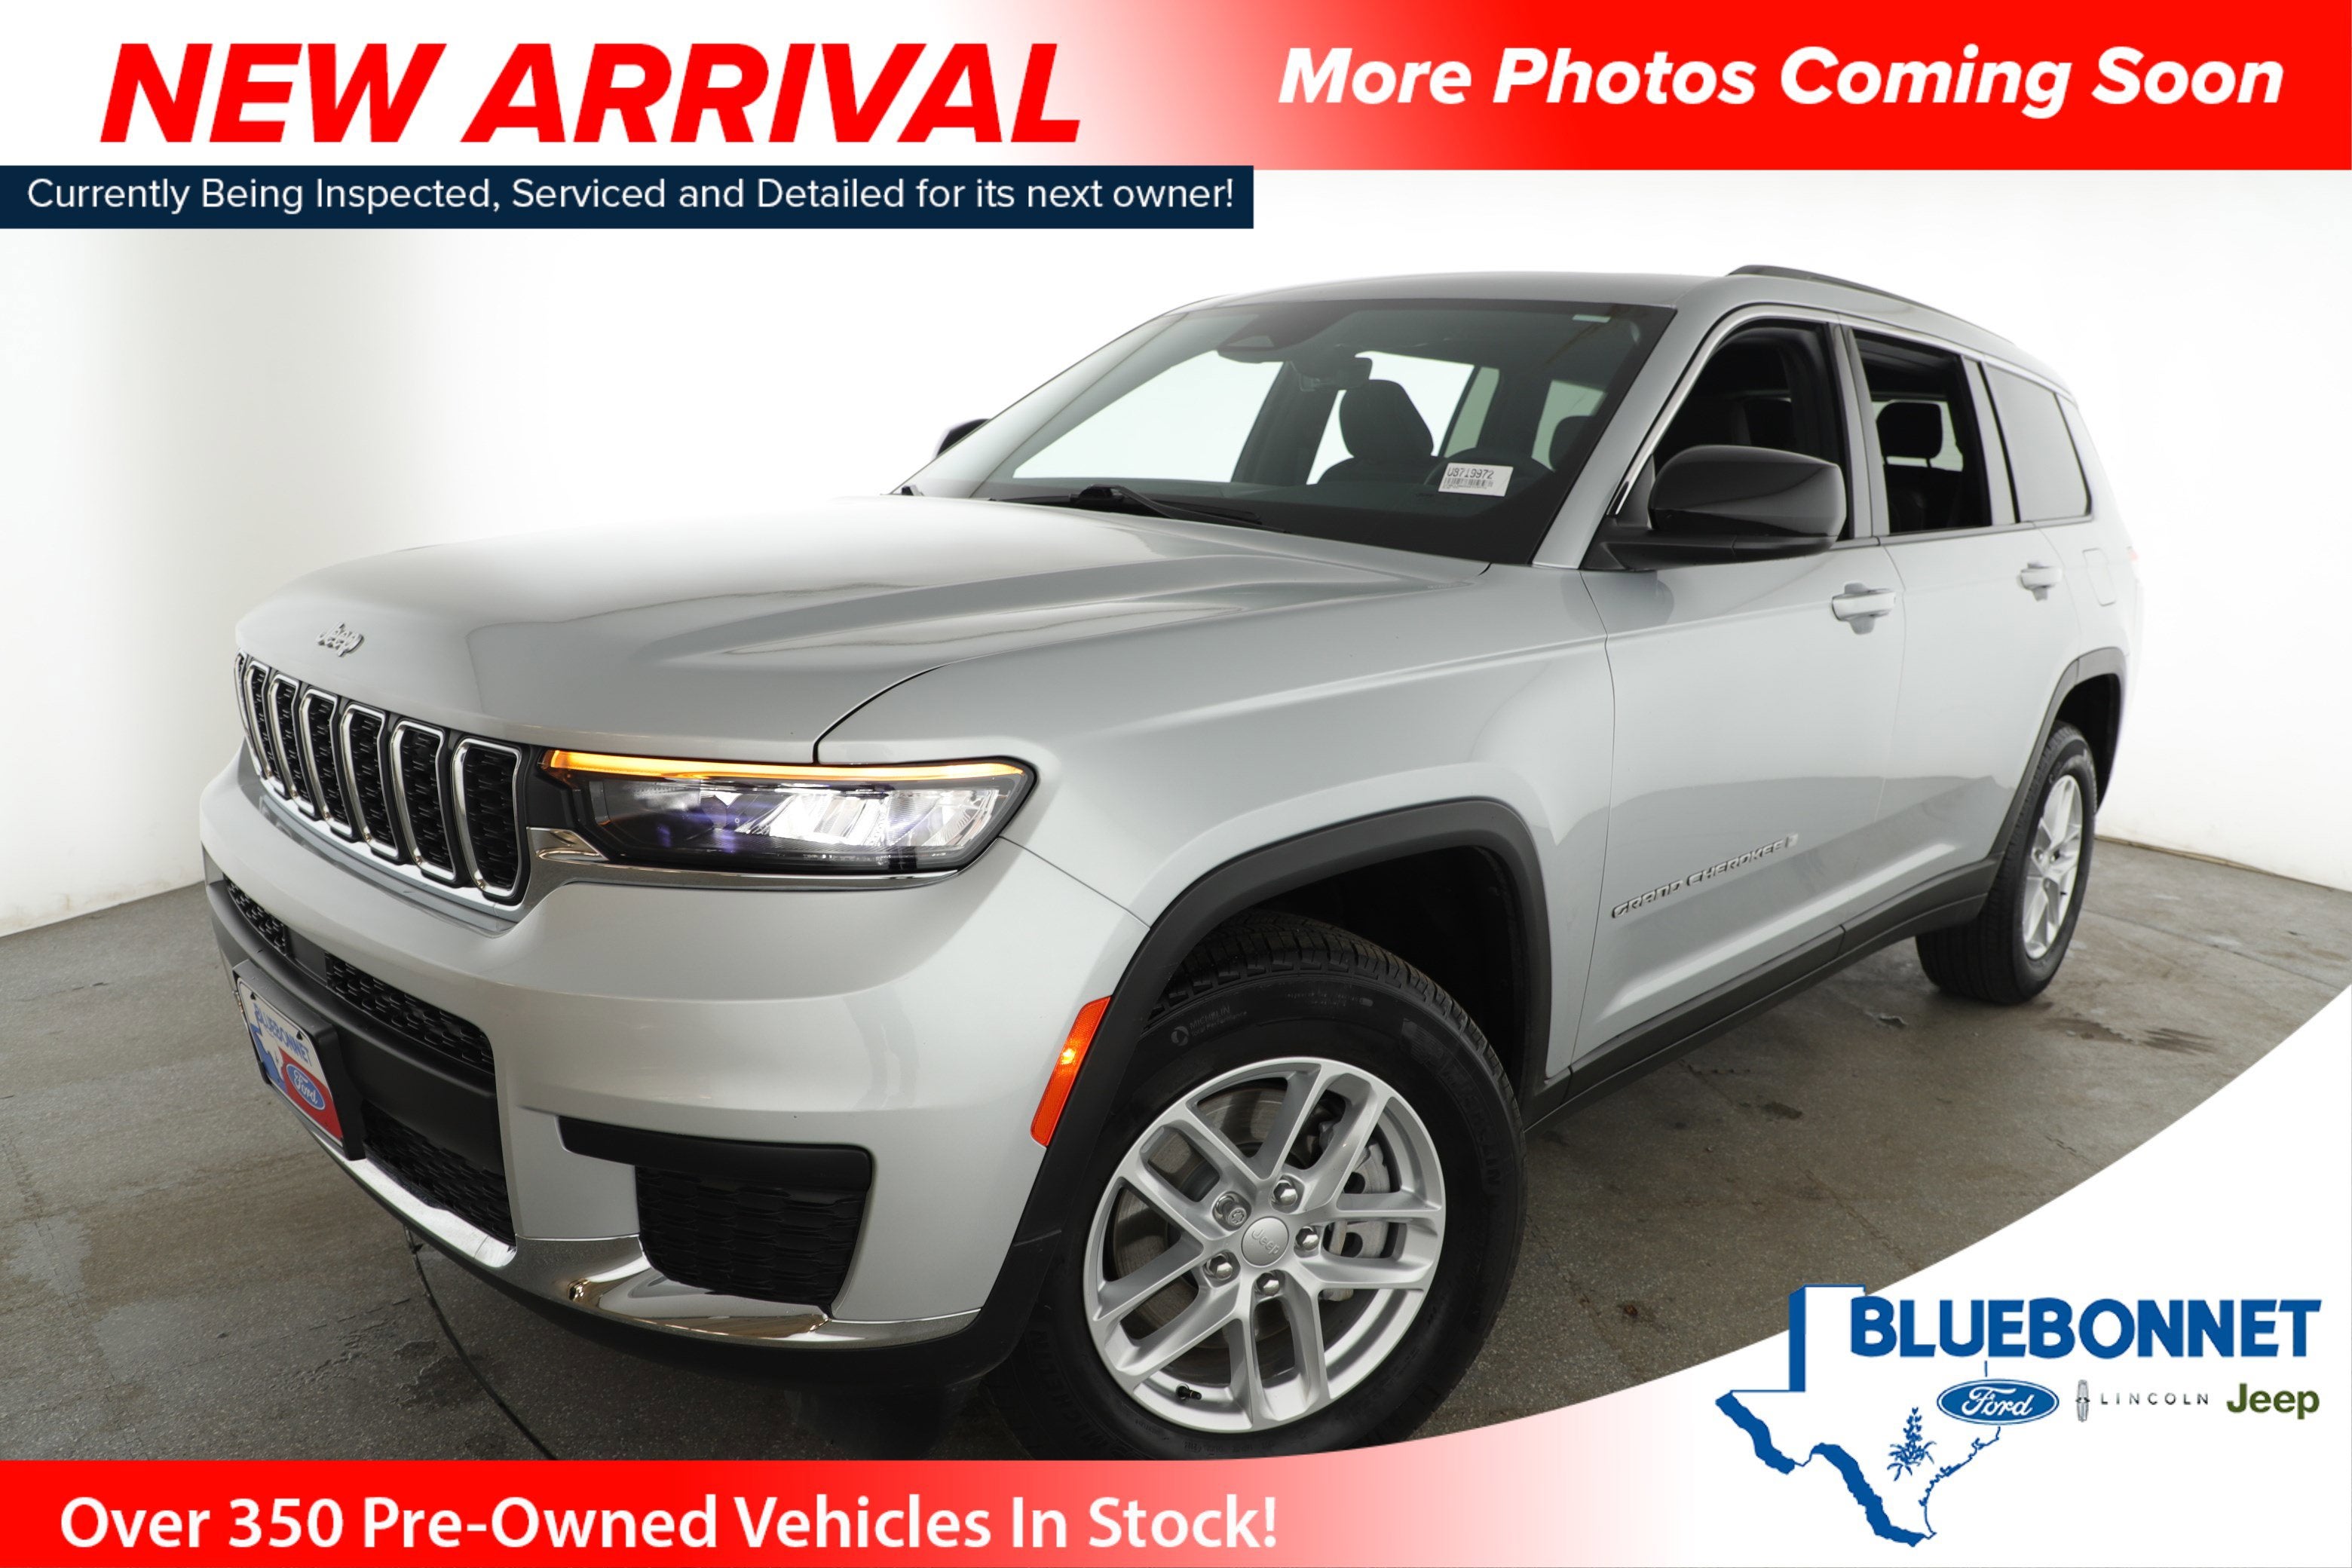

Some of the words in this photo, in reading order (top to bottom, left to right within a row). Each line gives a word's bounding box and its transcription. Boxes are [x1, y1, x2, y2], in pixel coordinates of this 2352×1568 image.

[315, 621, 364, 657] Jeep
[1612, 879, 1683, 918] GRAND
[1686, 839, 1784, 887] CHEROKEE
[253, 1002, 313, 1067] BLUEBONNET
[1190, 1005, 1231, 1031] MICHELIN
[293, 1069, 318, 1105] Ford
[1251, 1229, 1279, 1254] Jeep
